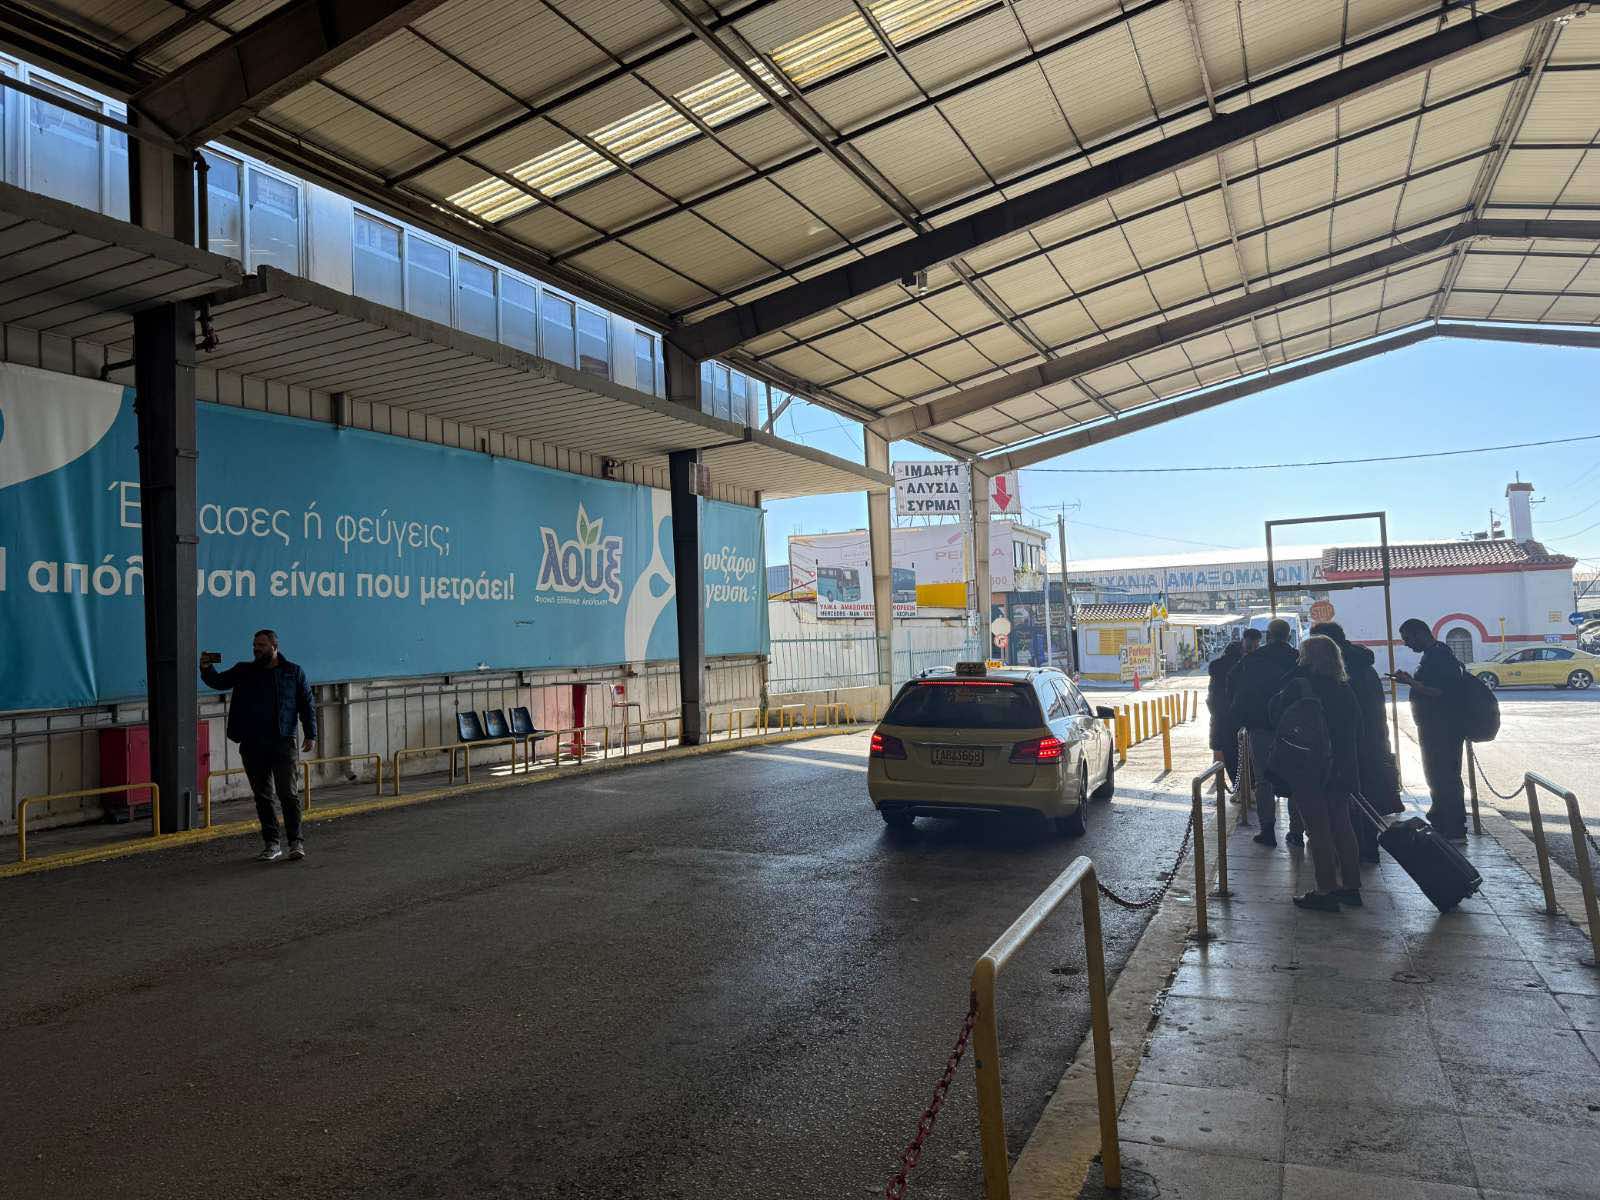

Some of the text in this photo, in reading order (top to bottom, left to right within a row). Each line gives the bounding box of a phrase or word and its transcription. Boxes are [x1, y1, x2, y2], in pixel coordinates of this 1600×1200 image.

[108, 481, 450, 558] Έασες ή φεύγεις;
[270, 561, 346, 598] είναι
[356, 572, 411, 599] που
[420, 570, 516, 606] μετράει!
[1312, 606, 1332, 619] STOP
